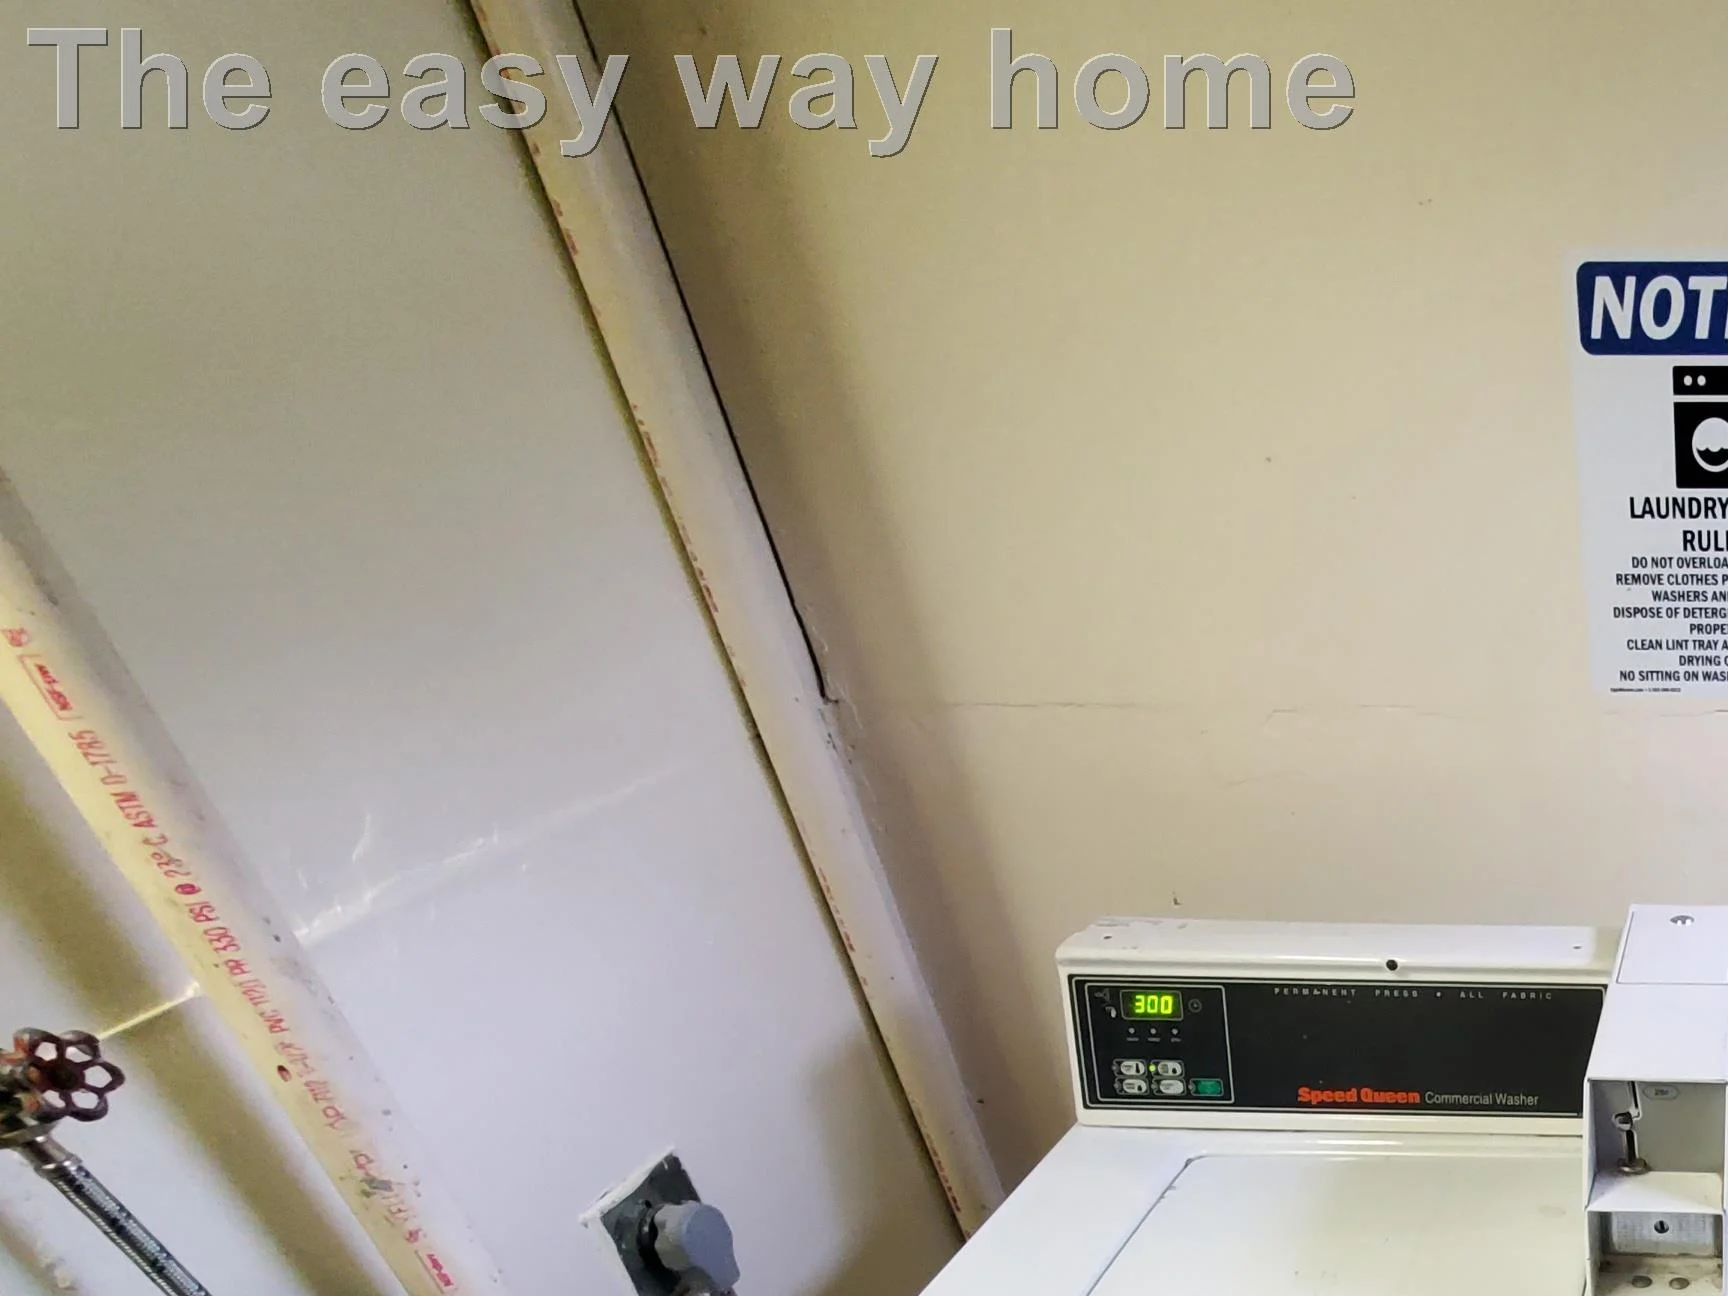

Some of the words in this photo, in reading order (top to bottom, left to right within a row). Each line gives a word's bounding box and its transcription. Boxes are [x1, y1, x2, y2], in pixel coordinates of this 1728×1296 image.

[1631, 556, 1648, 569] DO
[1651, 556, 1673, 569] NOT
[1616, 573, 1664, 586] REMOVE
[1667, 573, 1718, 586] CLOTHES
[1651, 590, 1708, 602] WASHERS
[1613, 607, 1663, 619] DISPOSE
[1666, 607, 1681, 619] OF
[1627, 639, 1663, 651] CLEAN
[1665, 639, 1689, 651] LINT
[1692, 639, 1720, 651] TRAY
[1679, 655, 1721, 667] DRYING
[1619, 670, 1635, 682] NO
[1638, 670, 1681, 682] SITTING
[1683, 670, 1700, 682] ON
[109, 790, 158, 829] ASTM
[183, 902, 220, 922] PSI
[201, 927, 241, 952] 330
[1274, 987, 1356, 997] PERMANENT
[1460, 991, 1483, 999] ALL
[1502, 991, 1552, 1000] FABRIC
[1135, 995, 1173, 1014] 300
[1298, 1087, 1357, 1104] Speed
[1360, 1088, 1420, 1103] Queen
[1424, 1091, 1493, 1105] Commercial
[1495, 1092, 1539, 1105] Washer
